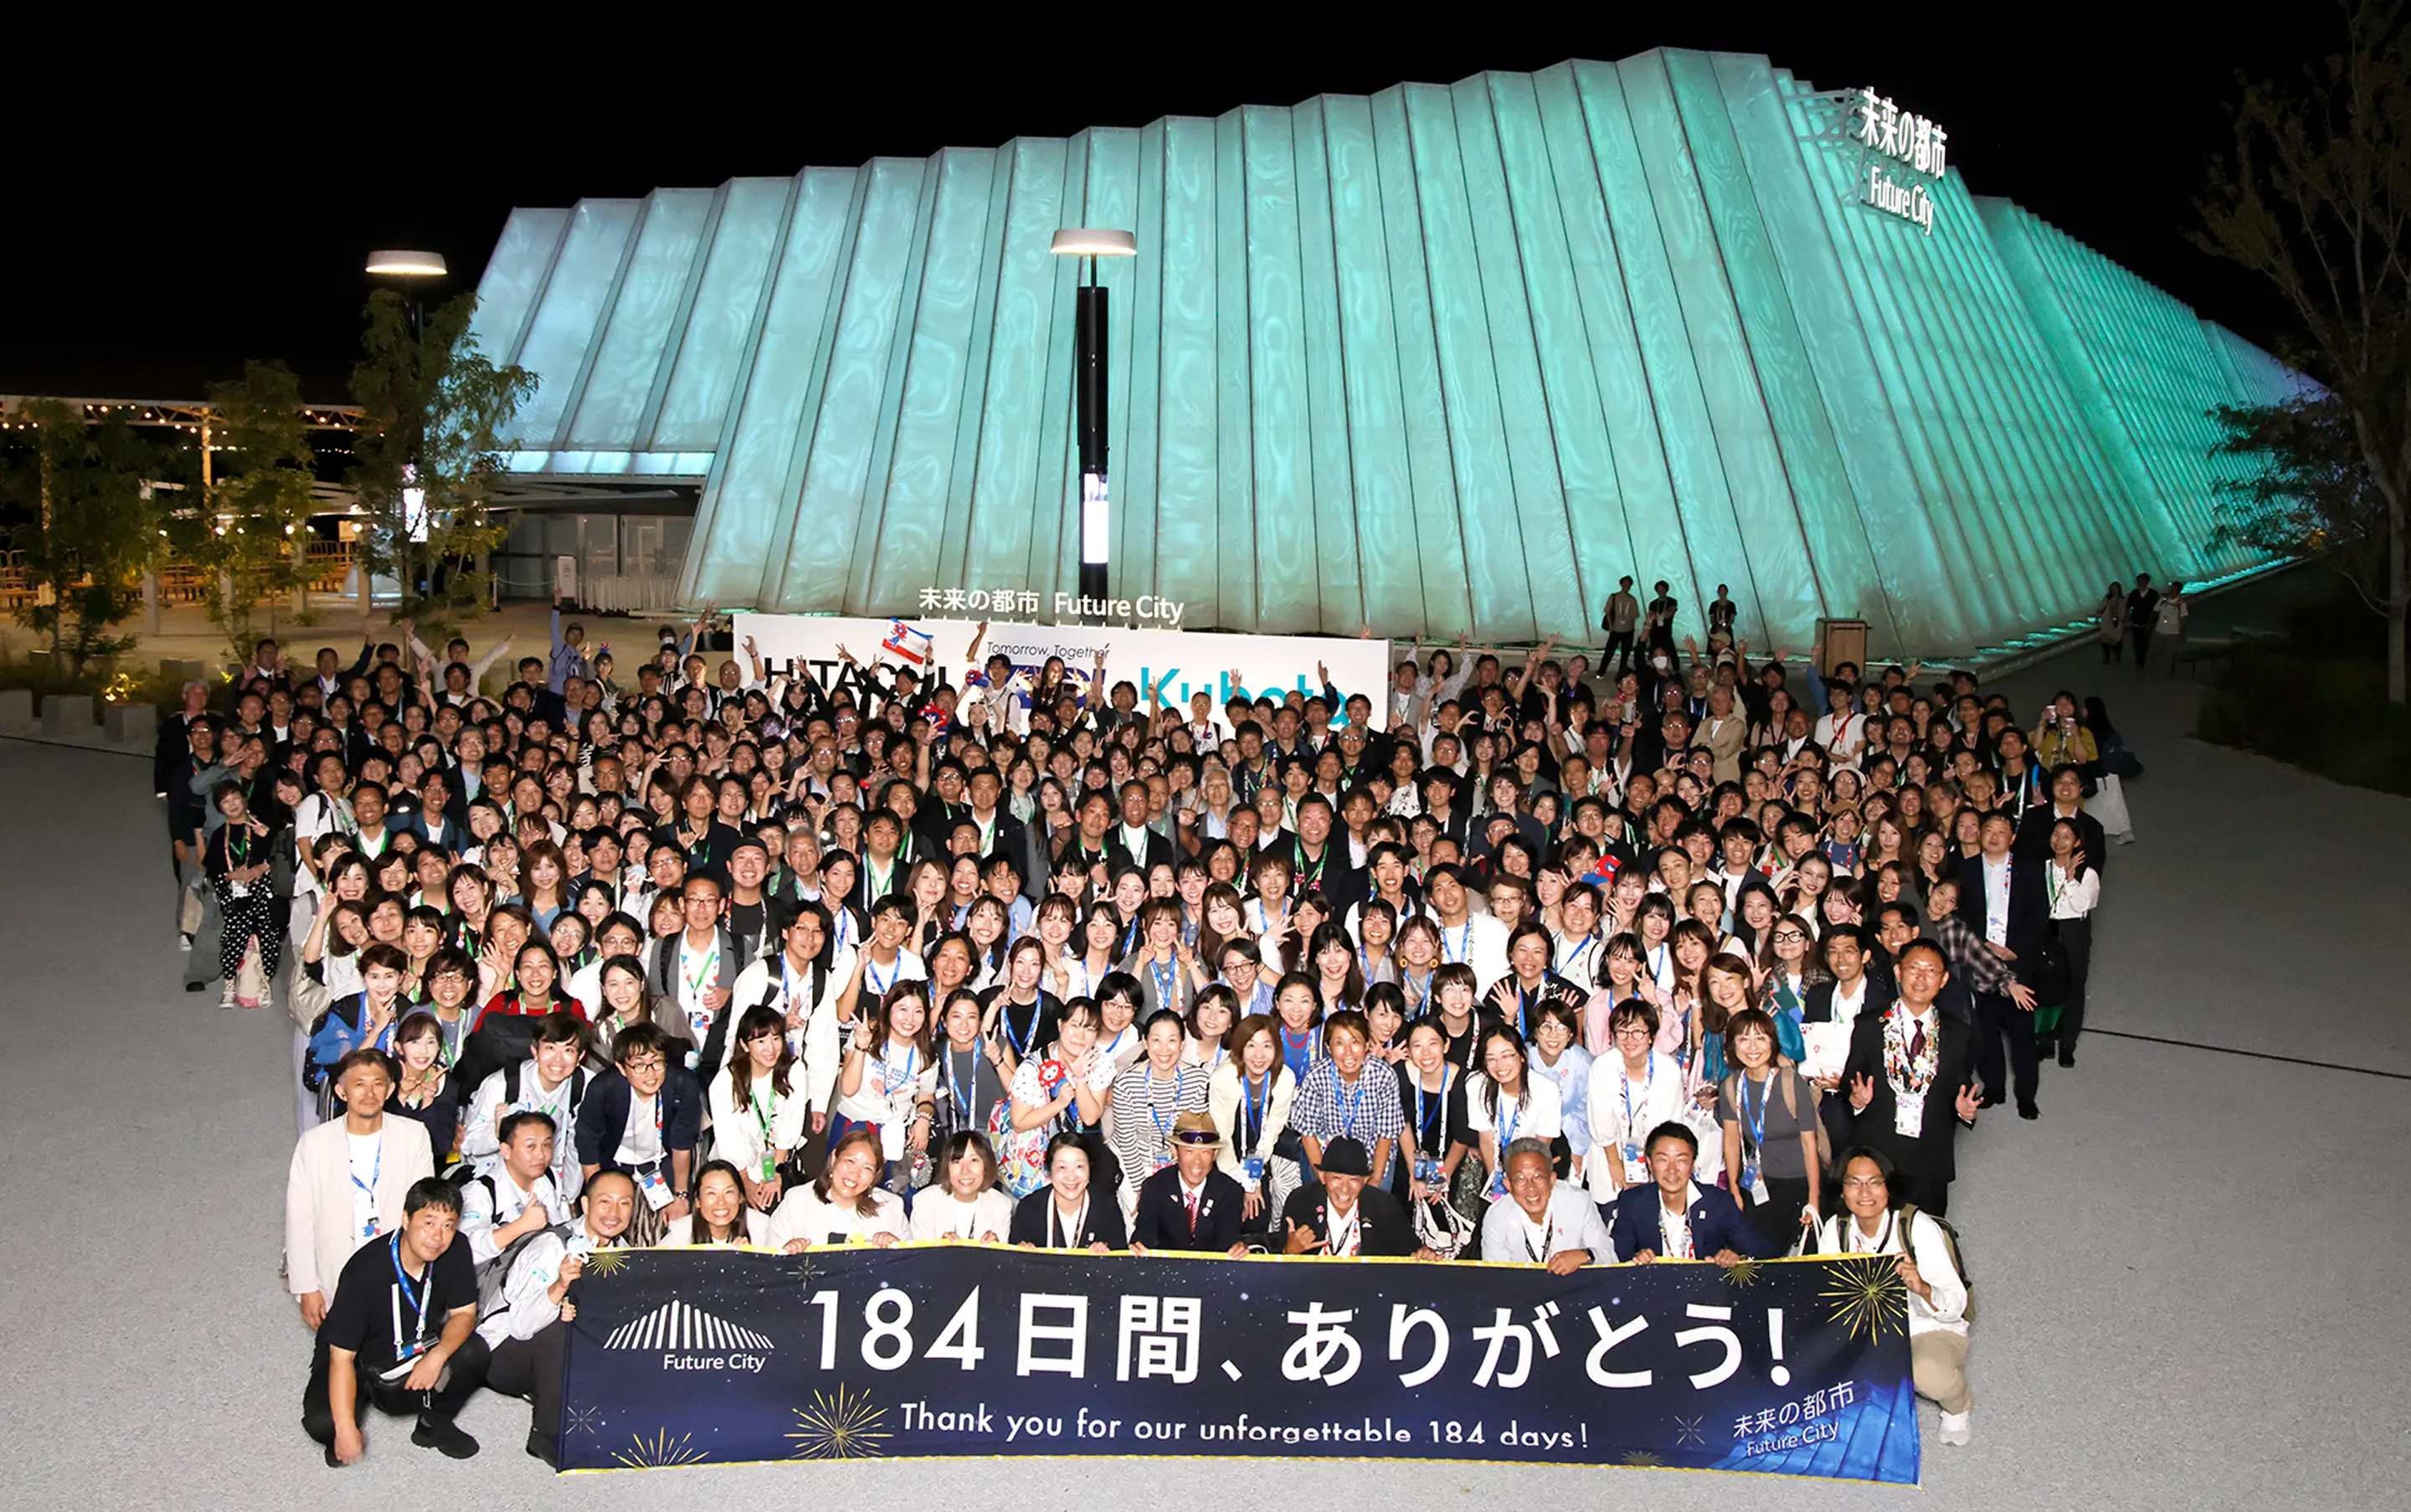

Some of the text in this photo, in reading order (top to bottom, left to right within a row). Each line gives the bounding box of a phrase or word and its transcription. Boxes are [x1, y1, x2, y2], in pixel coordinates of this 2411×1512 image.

[1860, 86, 1948, 179] 未来の都市
[1870, 166, 1935, 235] Future City
[918, 586, 1185, 625] 未来の都市 Future City
[987, 641, 1050, 657] Tomorrow,
[764, 657, 947, 696] HTACI
[663, 1353, 766, 1373] Future City
[900, 1401, 1589, 1450] Thank you for our unforgettable 184 days!
[1733, 1381, 1854, 1438] 未来の都市
[1746, 1421, 1839, 1456] Future City
